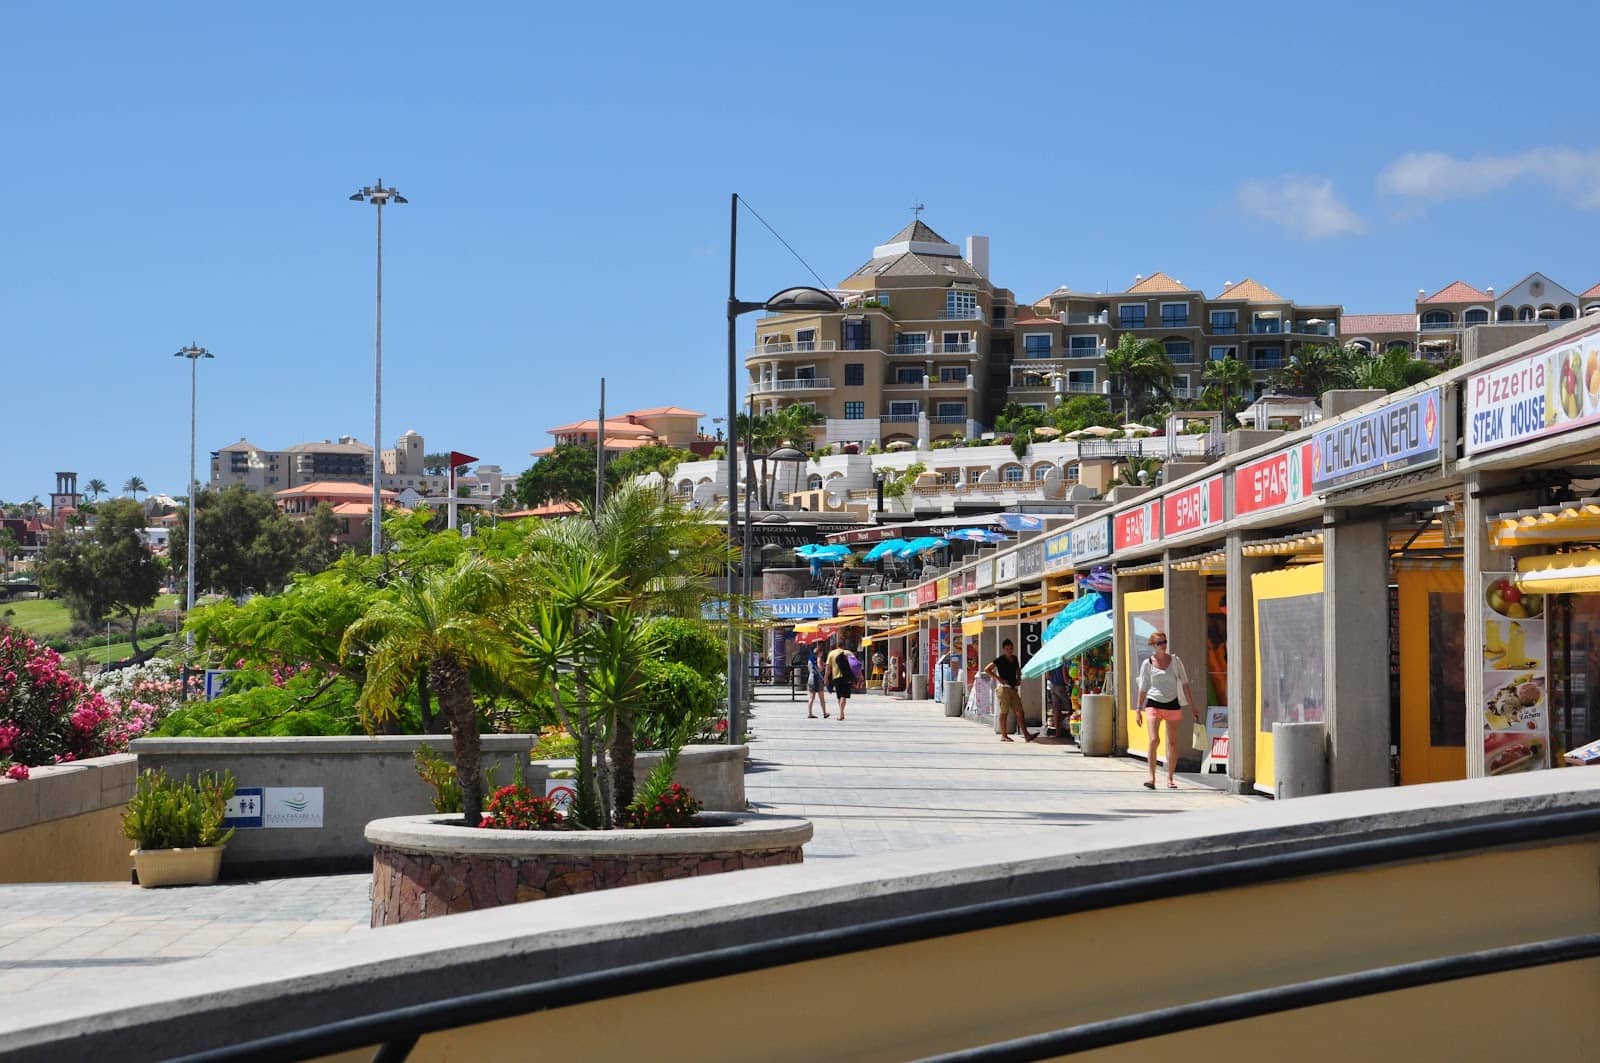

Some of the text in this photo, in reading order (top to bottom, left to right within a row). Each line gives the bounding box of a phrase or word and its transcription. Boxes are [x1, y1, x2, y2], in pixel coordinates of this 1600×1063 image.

[1476, 359, 1545, 408] Pizzería
[1473, 395, 1545, 445] STEAK HOUSE
[1325, 417, 1377, 474] CHICKEN
[1254, 460, 1288, 503] SPAR
[1125, 512, 1145, 543] SPAR
[1176, 493, 1200, 527] SPAR
